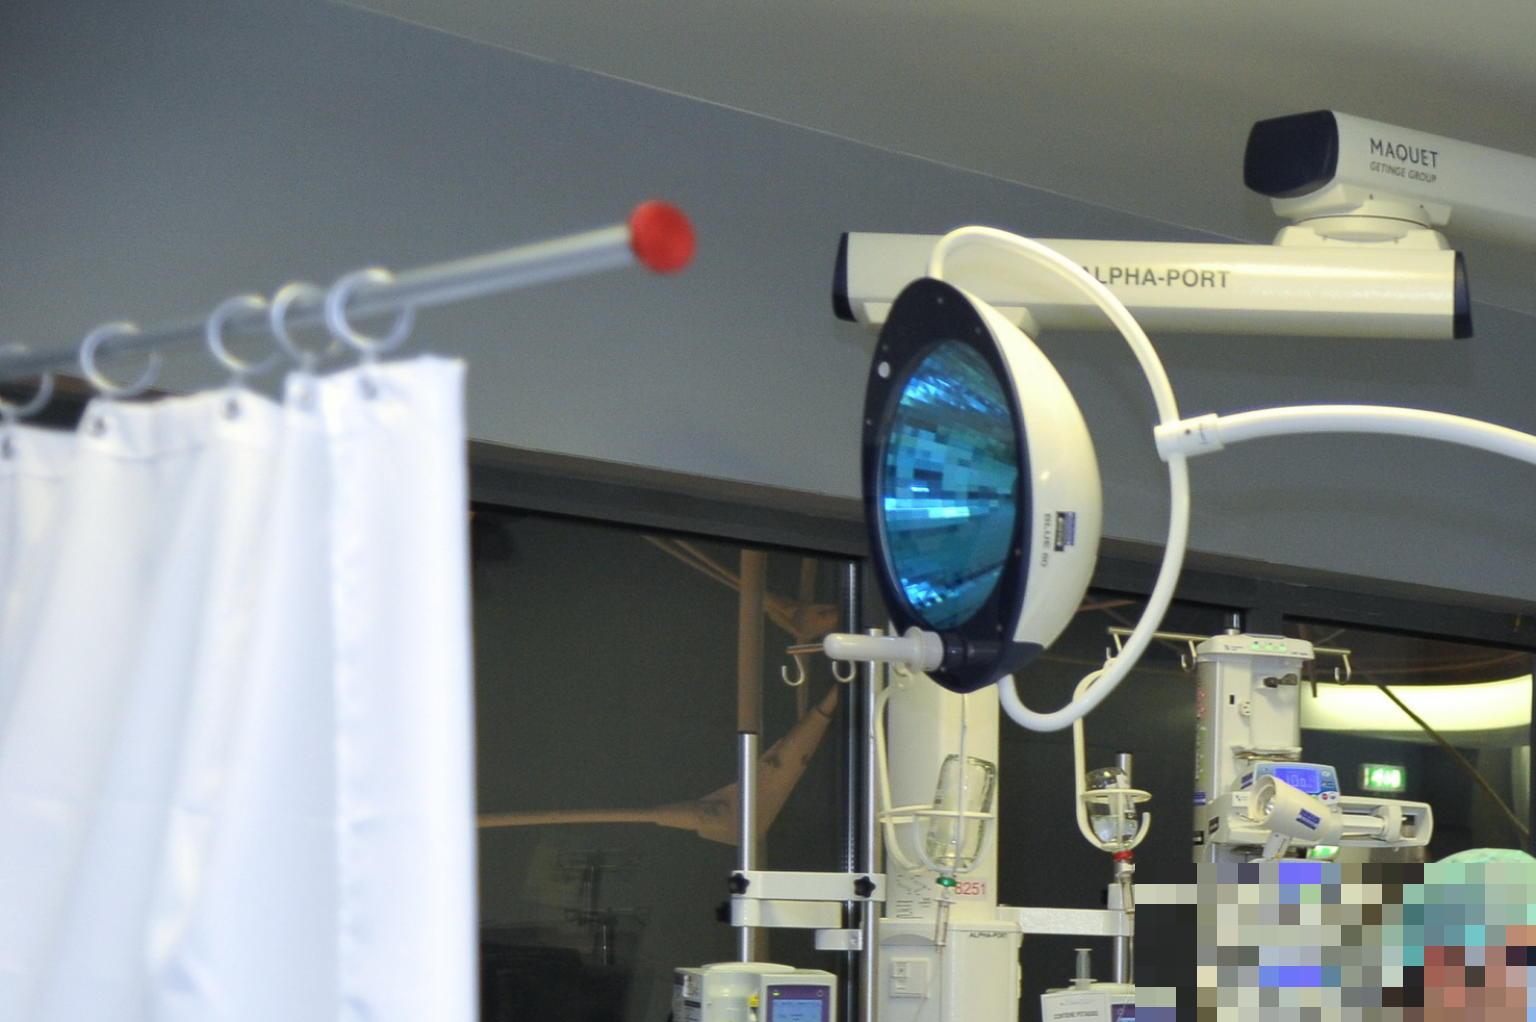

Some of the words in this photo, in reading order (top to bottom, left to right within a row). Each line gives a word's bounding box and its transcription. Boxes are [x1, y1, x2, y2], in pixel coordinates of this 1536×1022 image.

[1369, 137, 1438, 169] MAQUET
[1369, 160, 1407, 178] GETINGE
[1407, 169, 1438, 183] GROUP
